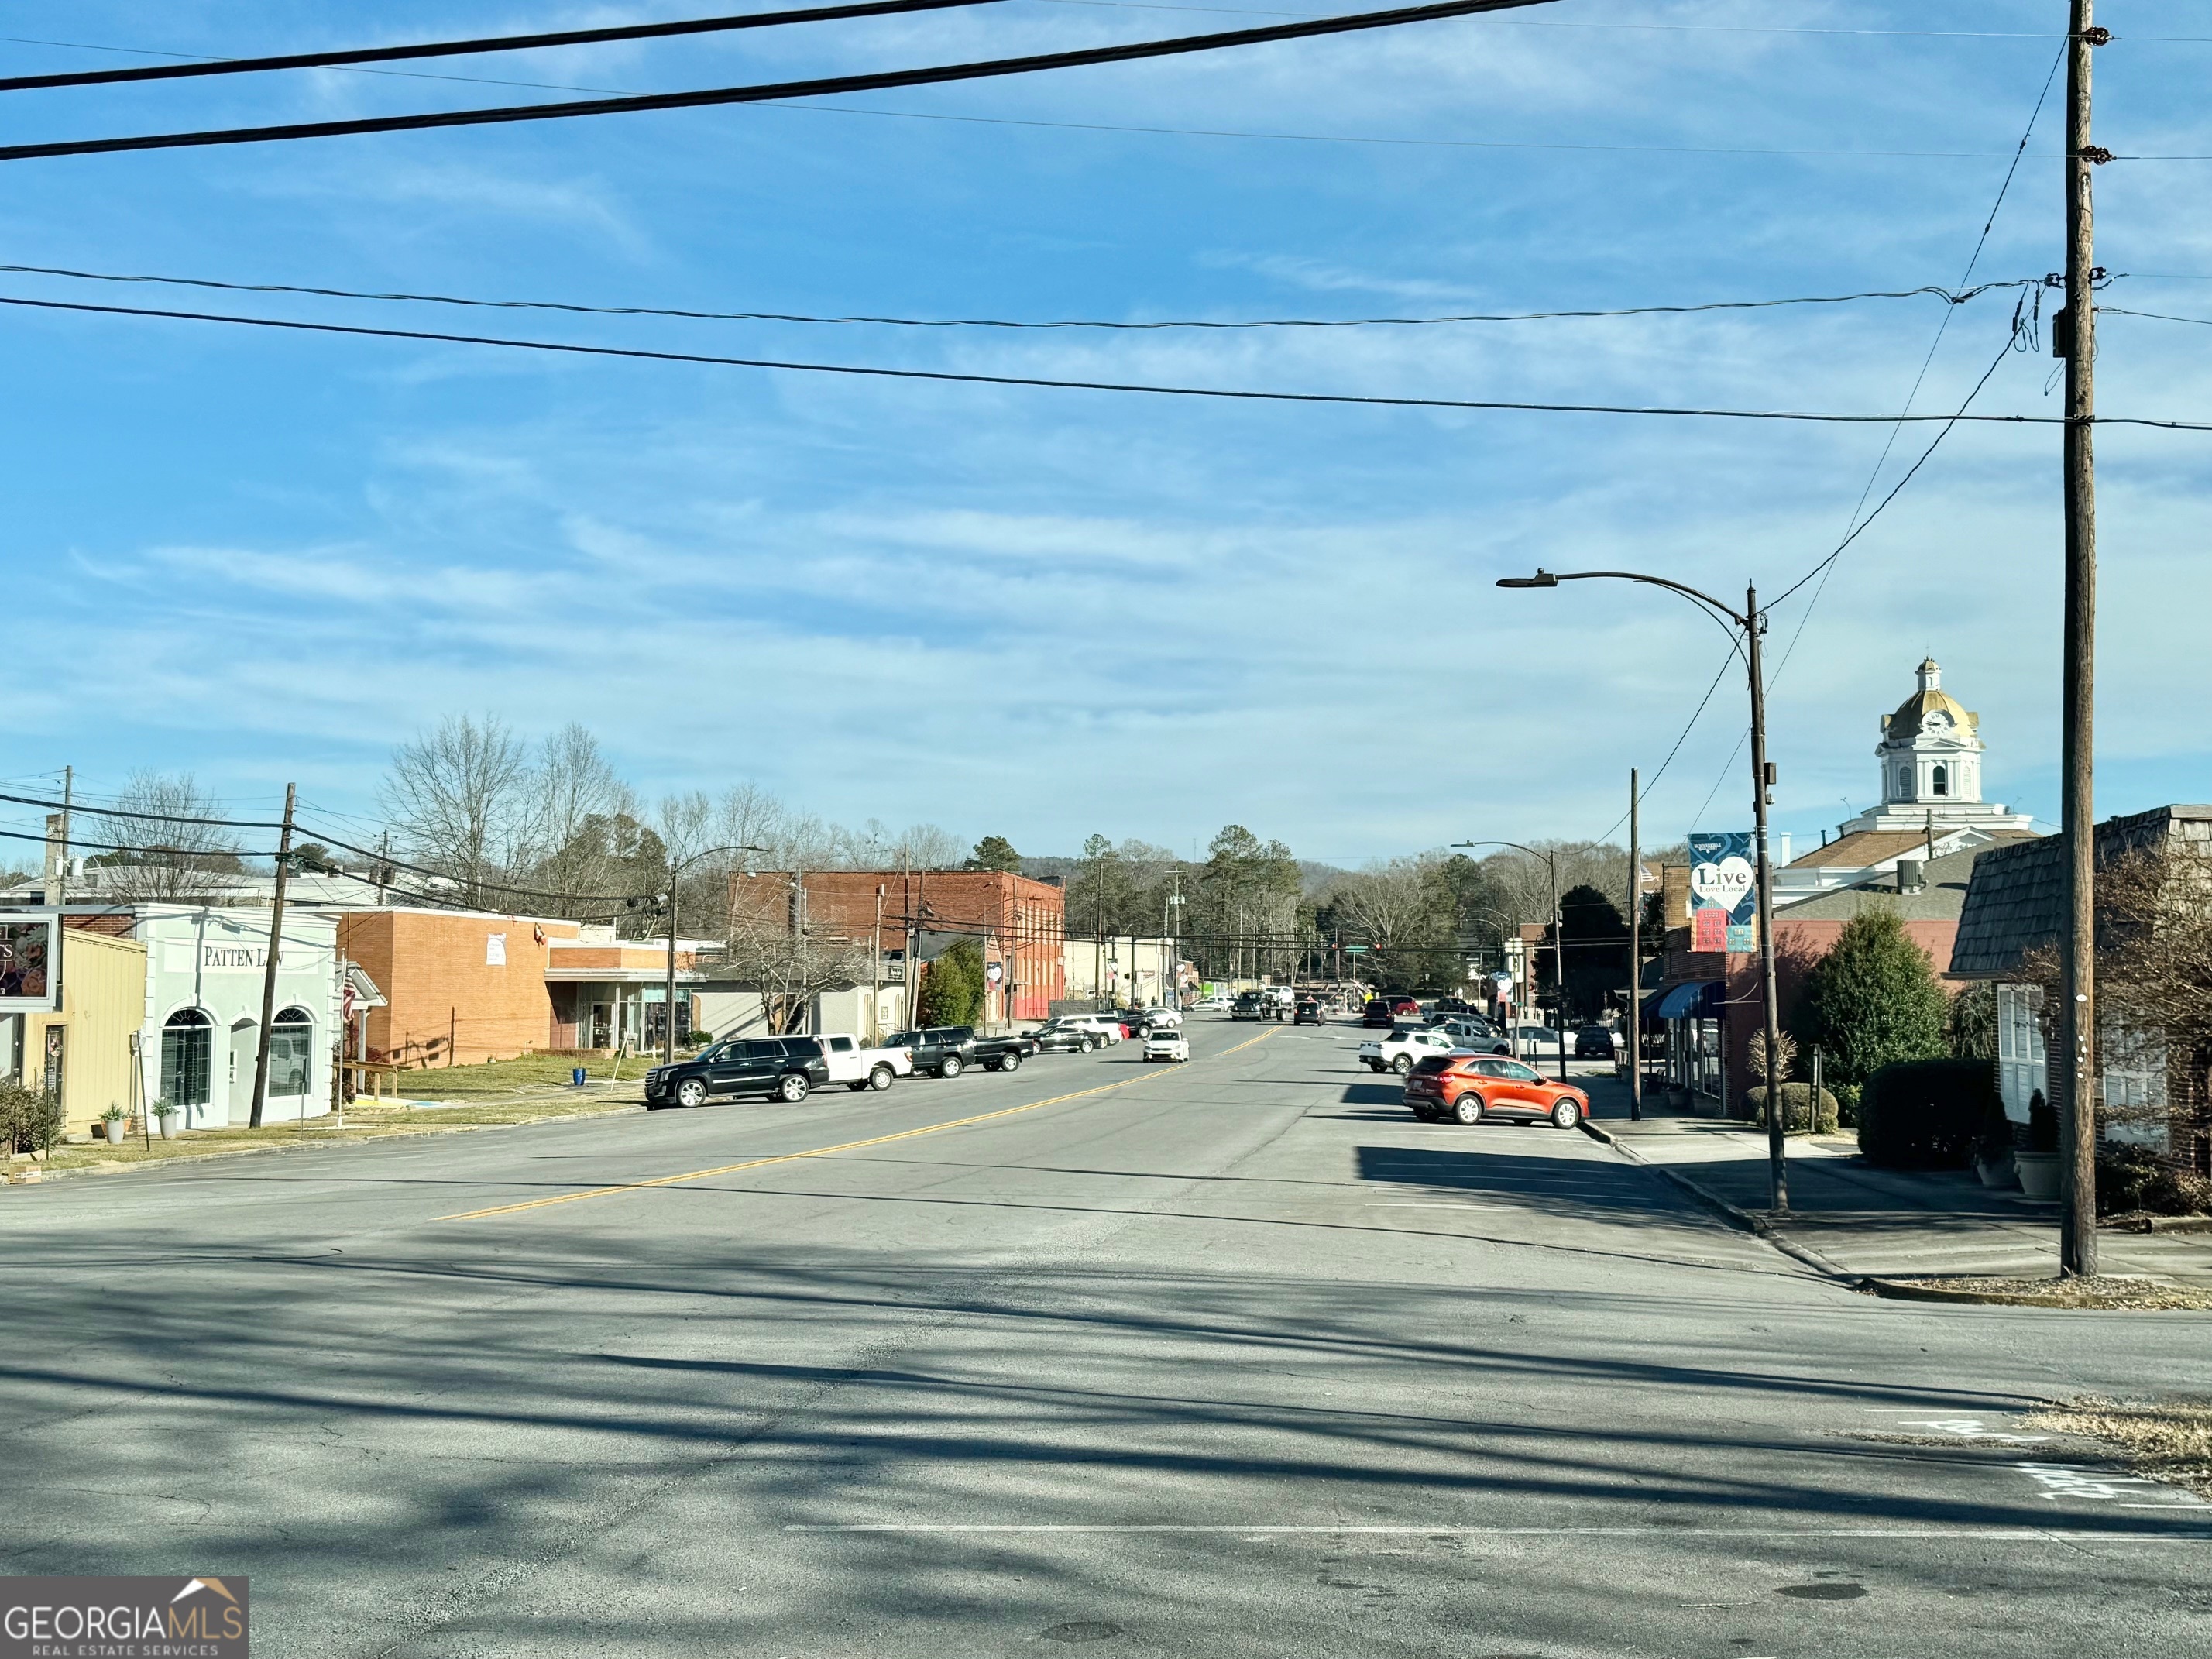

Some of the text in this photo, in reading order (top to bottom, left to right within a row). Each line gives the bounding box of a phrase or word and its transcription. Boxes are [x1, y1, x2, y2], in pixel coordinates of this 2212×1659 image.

[1698, 868, 1747, 885] Live
[1723, 884, 1746, 893] Local
[256, 948, 283, 967] LW
